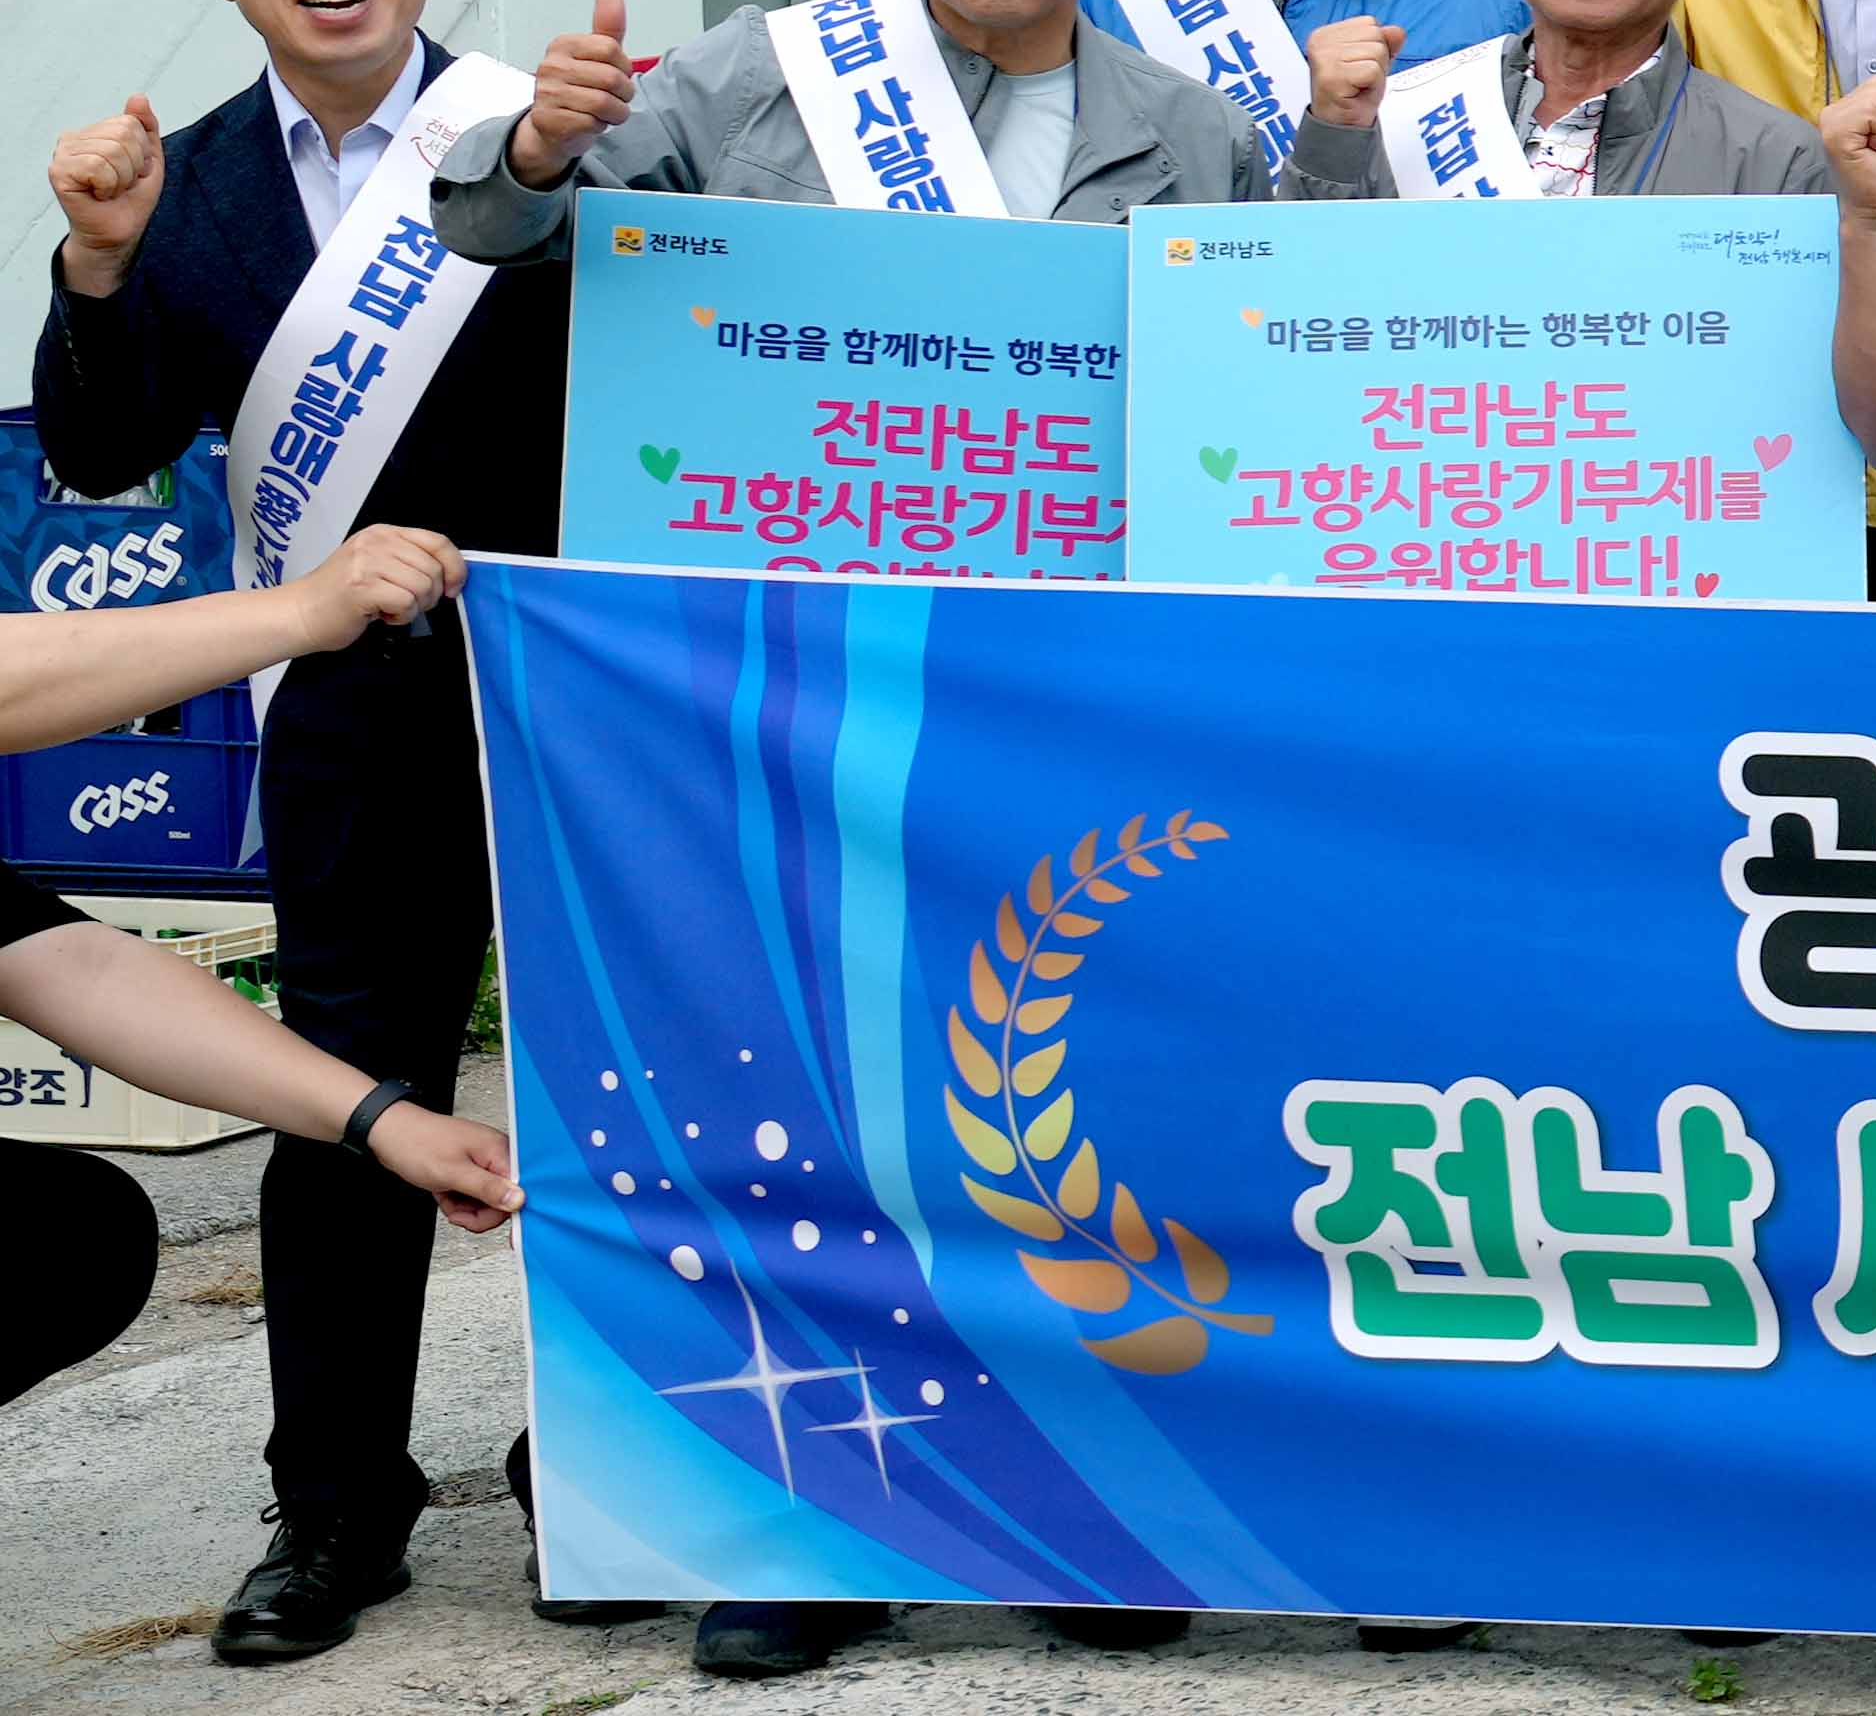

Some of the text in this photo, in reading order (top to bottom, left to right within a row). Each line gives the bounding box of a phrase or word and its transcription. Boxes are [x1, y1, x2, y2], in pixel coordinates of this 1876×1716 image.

[1418, 93, 1479, 187] 전남
[348, 215, 448, 330] 전남
[648, 232, 729, 257] 전라남도
[1200, 239, 1273, 262] 전라남도
[717, 320, 1120, 380] 마음을 함께하는 행복한
[1265, 311, 1730, 352] 마음을 함께하는 행복한 이음
[812, 400, 1100, 475] 전라남도
[1362, 382, 1637, 450] 전라남도
[1228, 457, 1767, 532] 고향사랑기부제를
[1311, 1091, 1760, 1351] 전남
